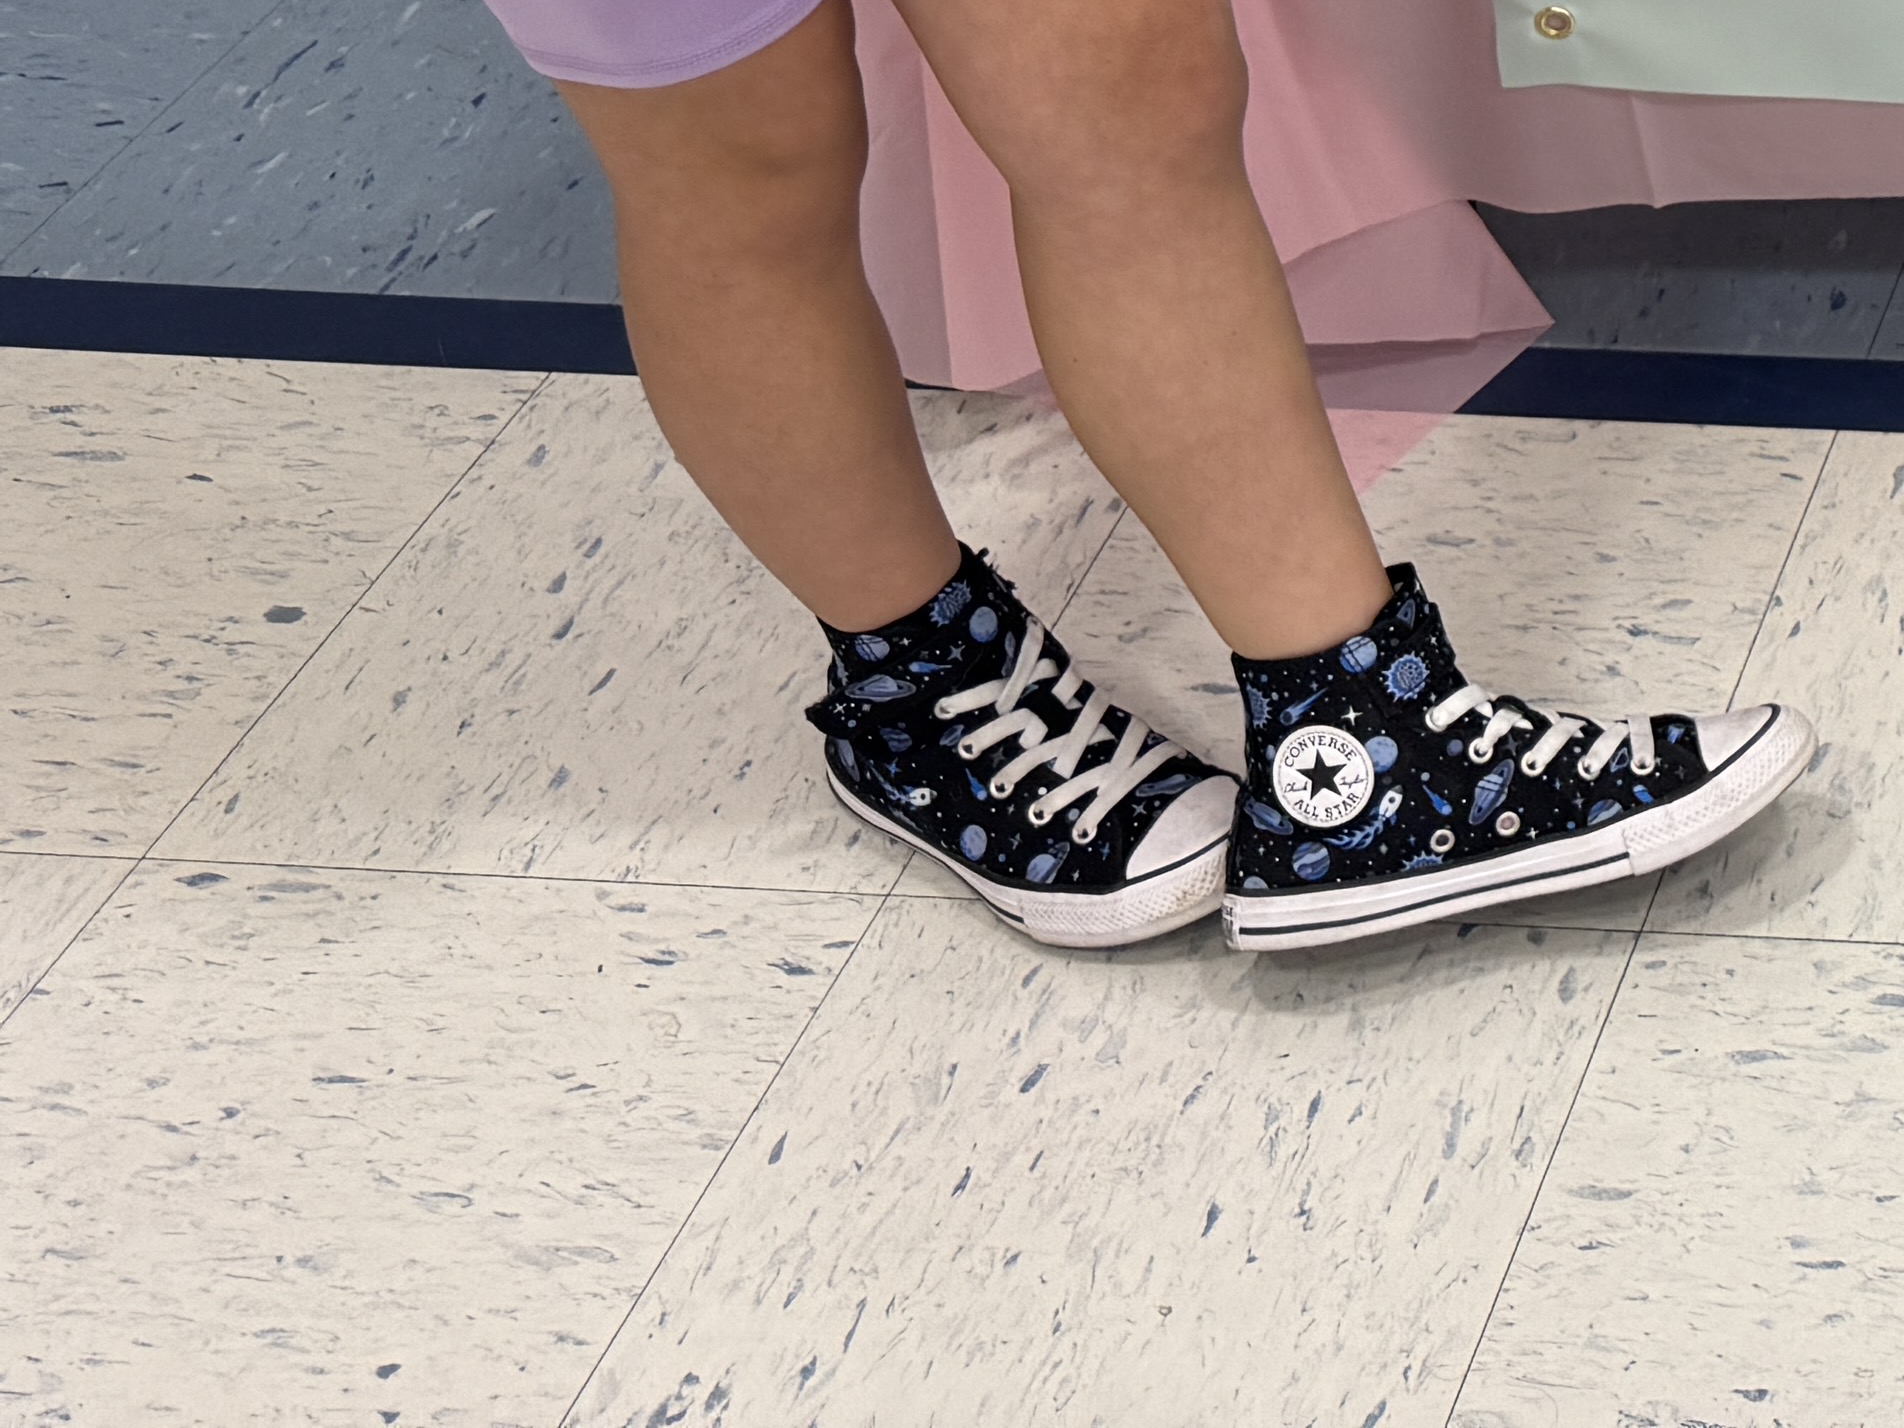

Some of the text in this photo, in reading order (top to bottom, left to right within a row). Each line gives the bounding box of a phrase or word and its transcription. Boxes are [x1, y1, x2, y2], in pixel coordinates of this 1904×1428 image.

[1284, 735, 1357, 768] CONVERSE
[1294, 792, 1360, 819] ALL STAR
